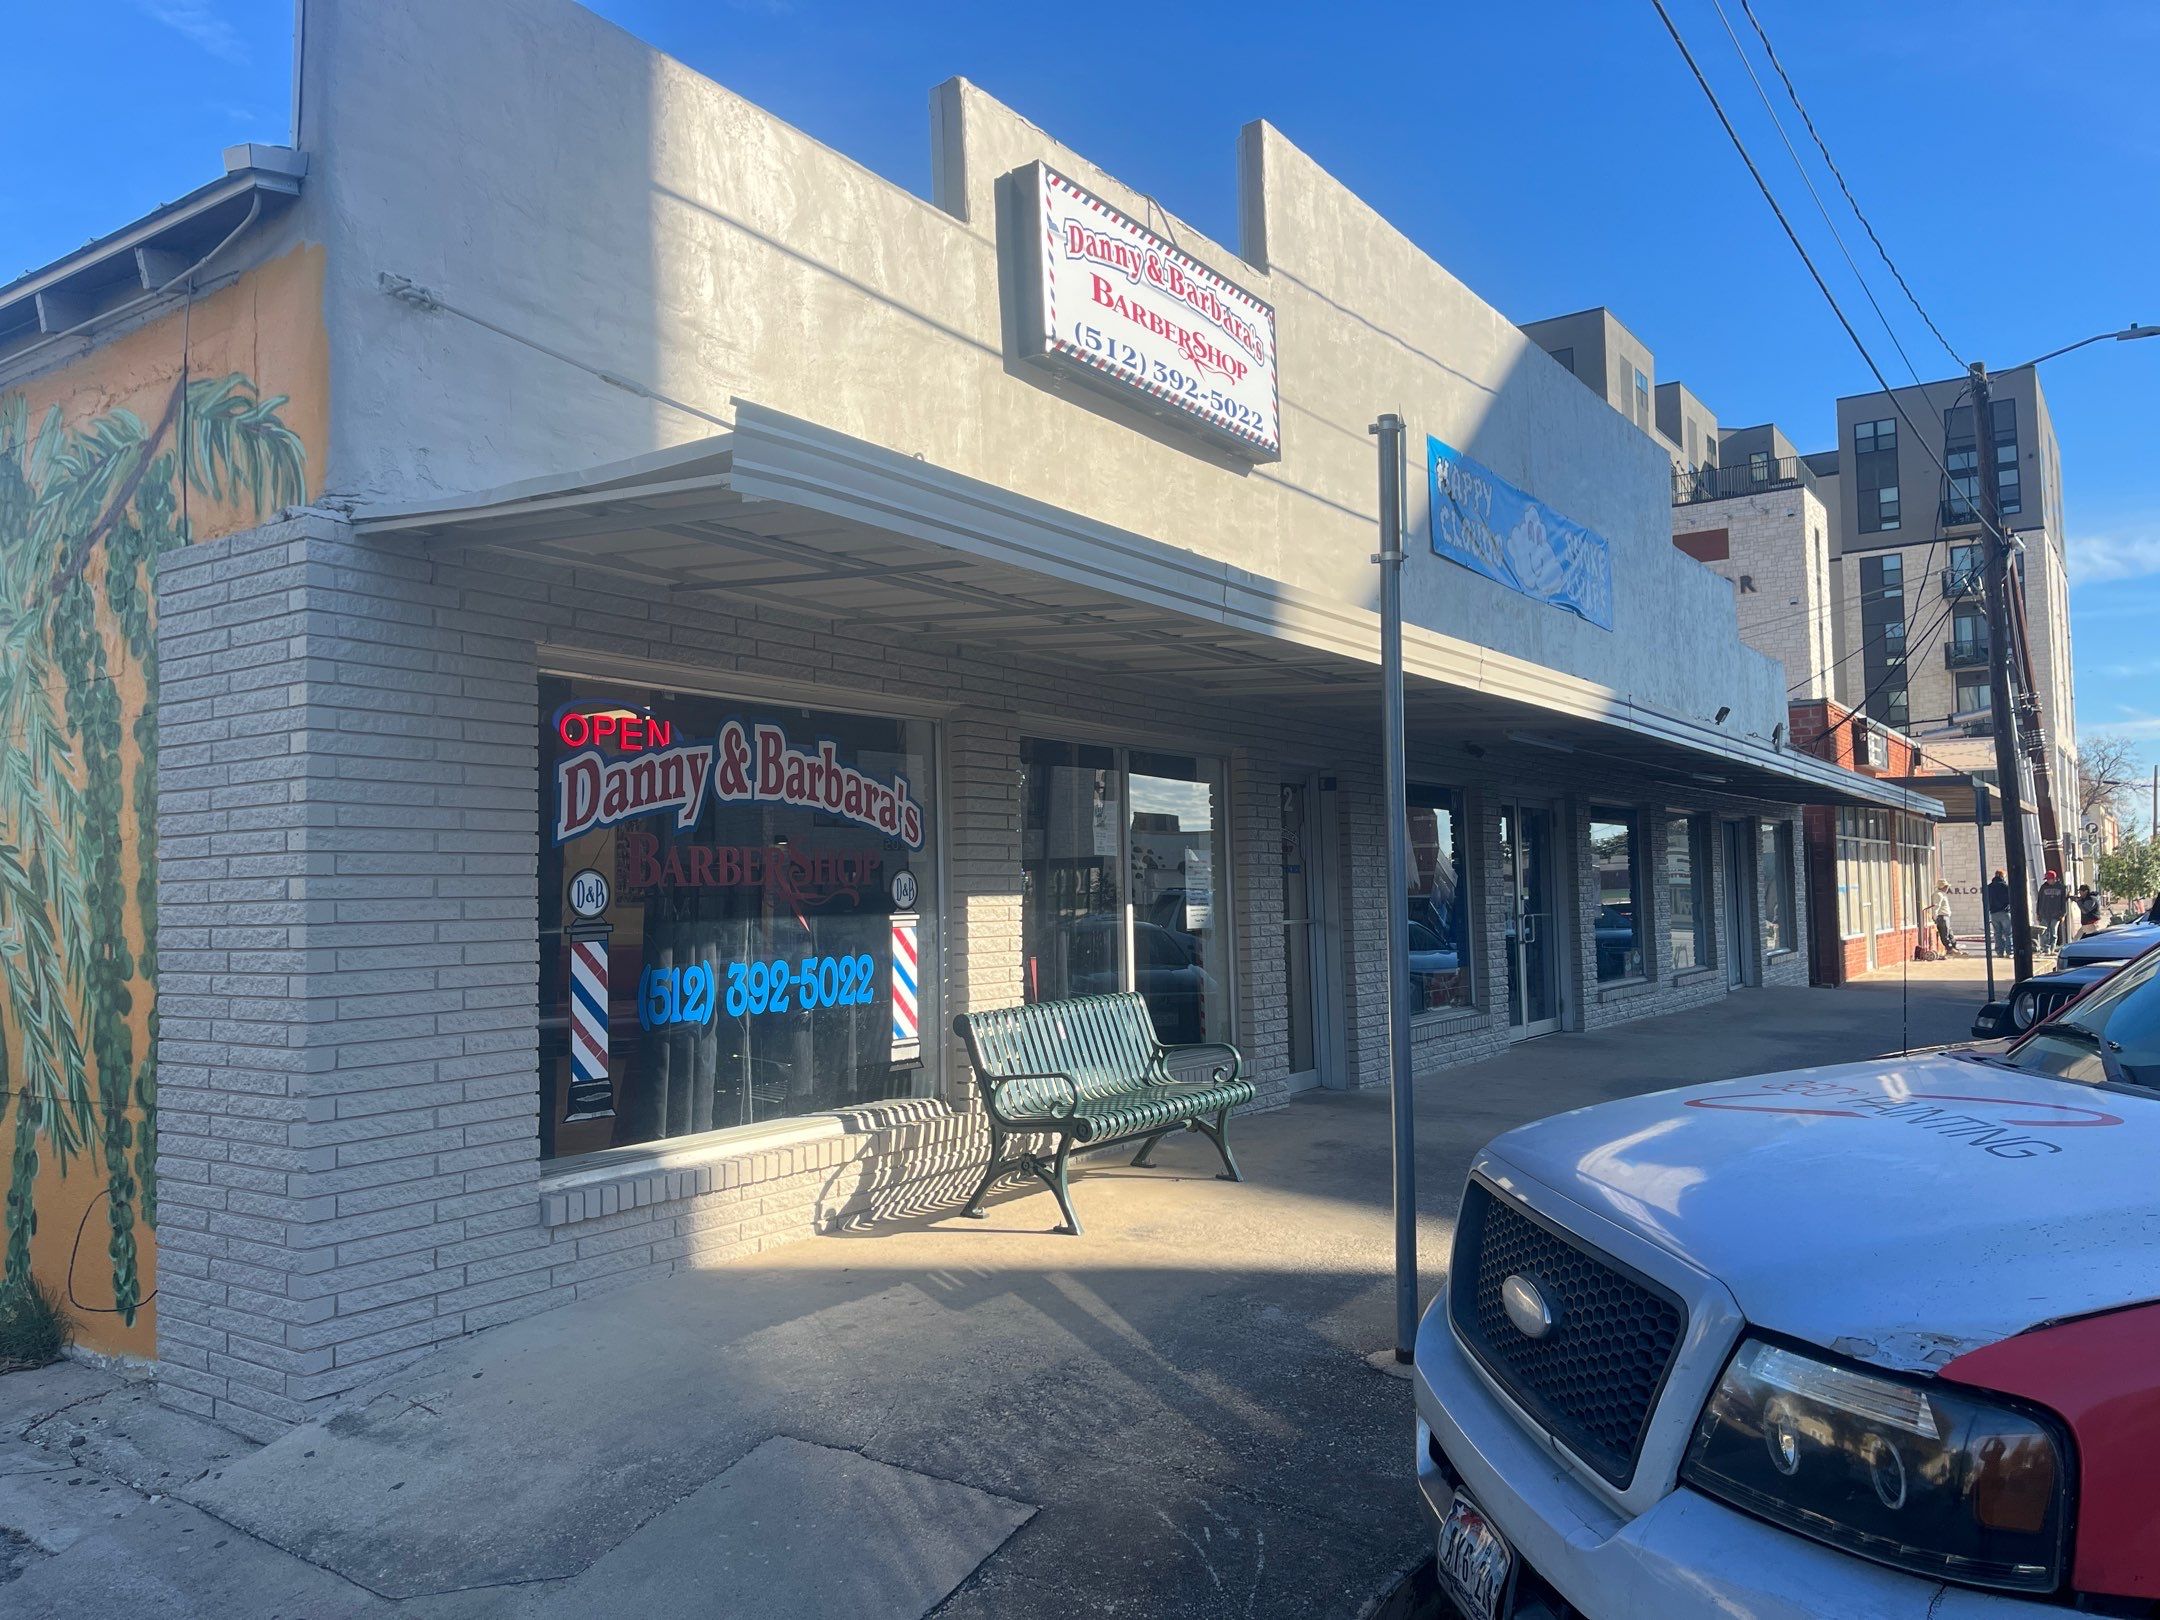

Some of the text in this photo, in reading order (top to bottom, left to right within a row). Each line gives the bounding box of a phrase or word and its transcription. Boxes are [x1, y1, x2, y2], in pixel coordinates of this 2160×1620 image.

[1065, 221, 1264, 362] Danny & Barbara's
[1075, 322, 1264, 432] (512) 392-5022
[1436, 456, 1492, 518] HAPPY
[560, 713, 670, 751] OPEN
[562, 727, 919, 843] Danny & Barbara's
[637, 954, 875, 1031] (512) 392-5022
[1838, 1095, 2063, 1159] PAINTING
